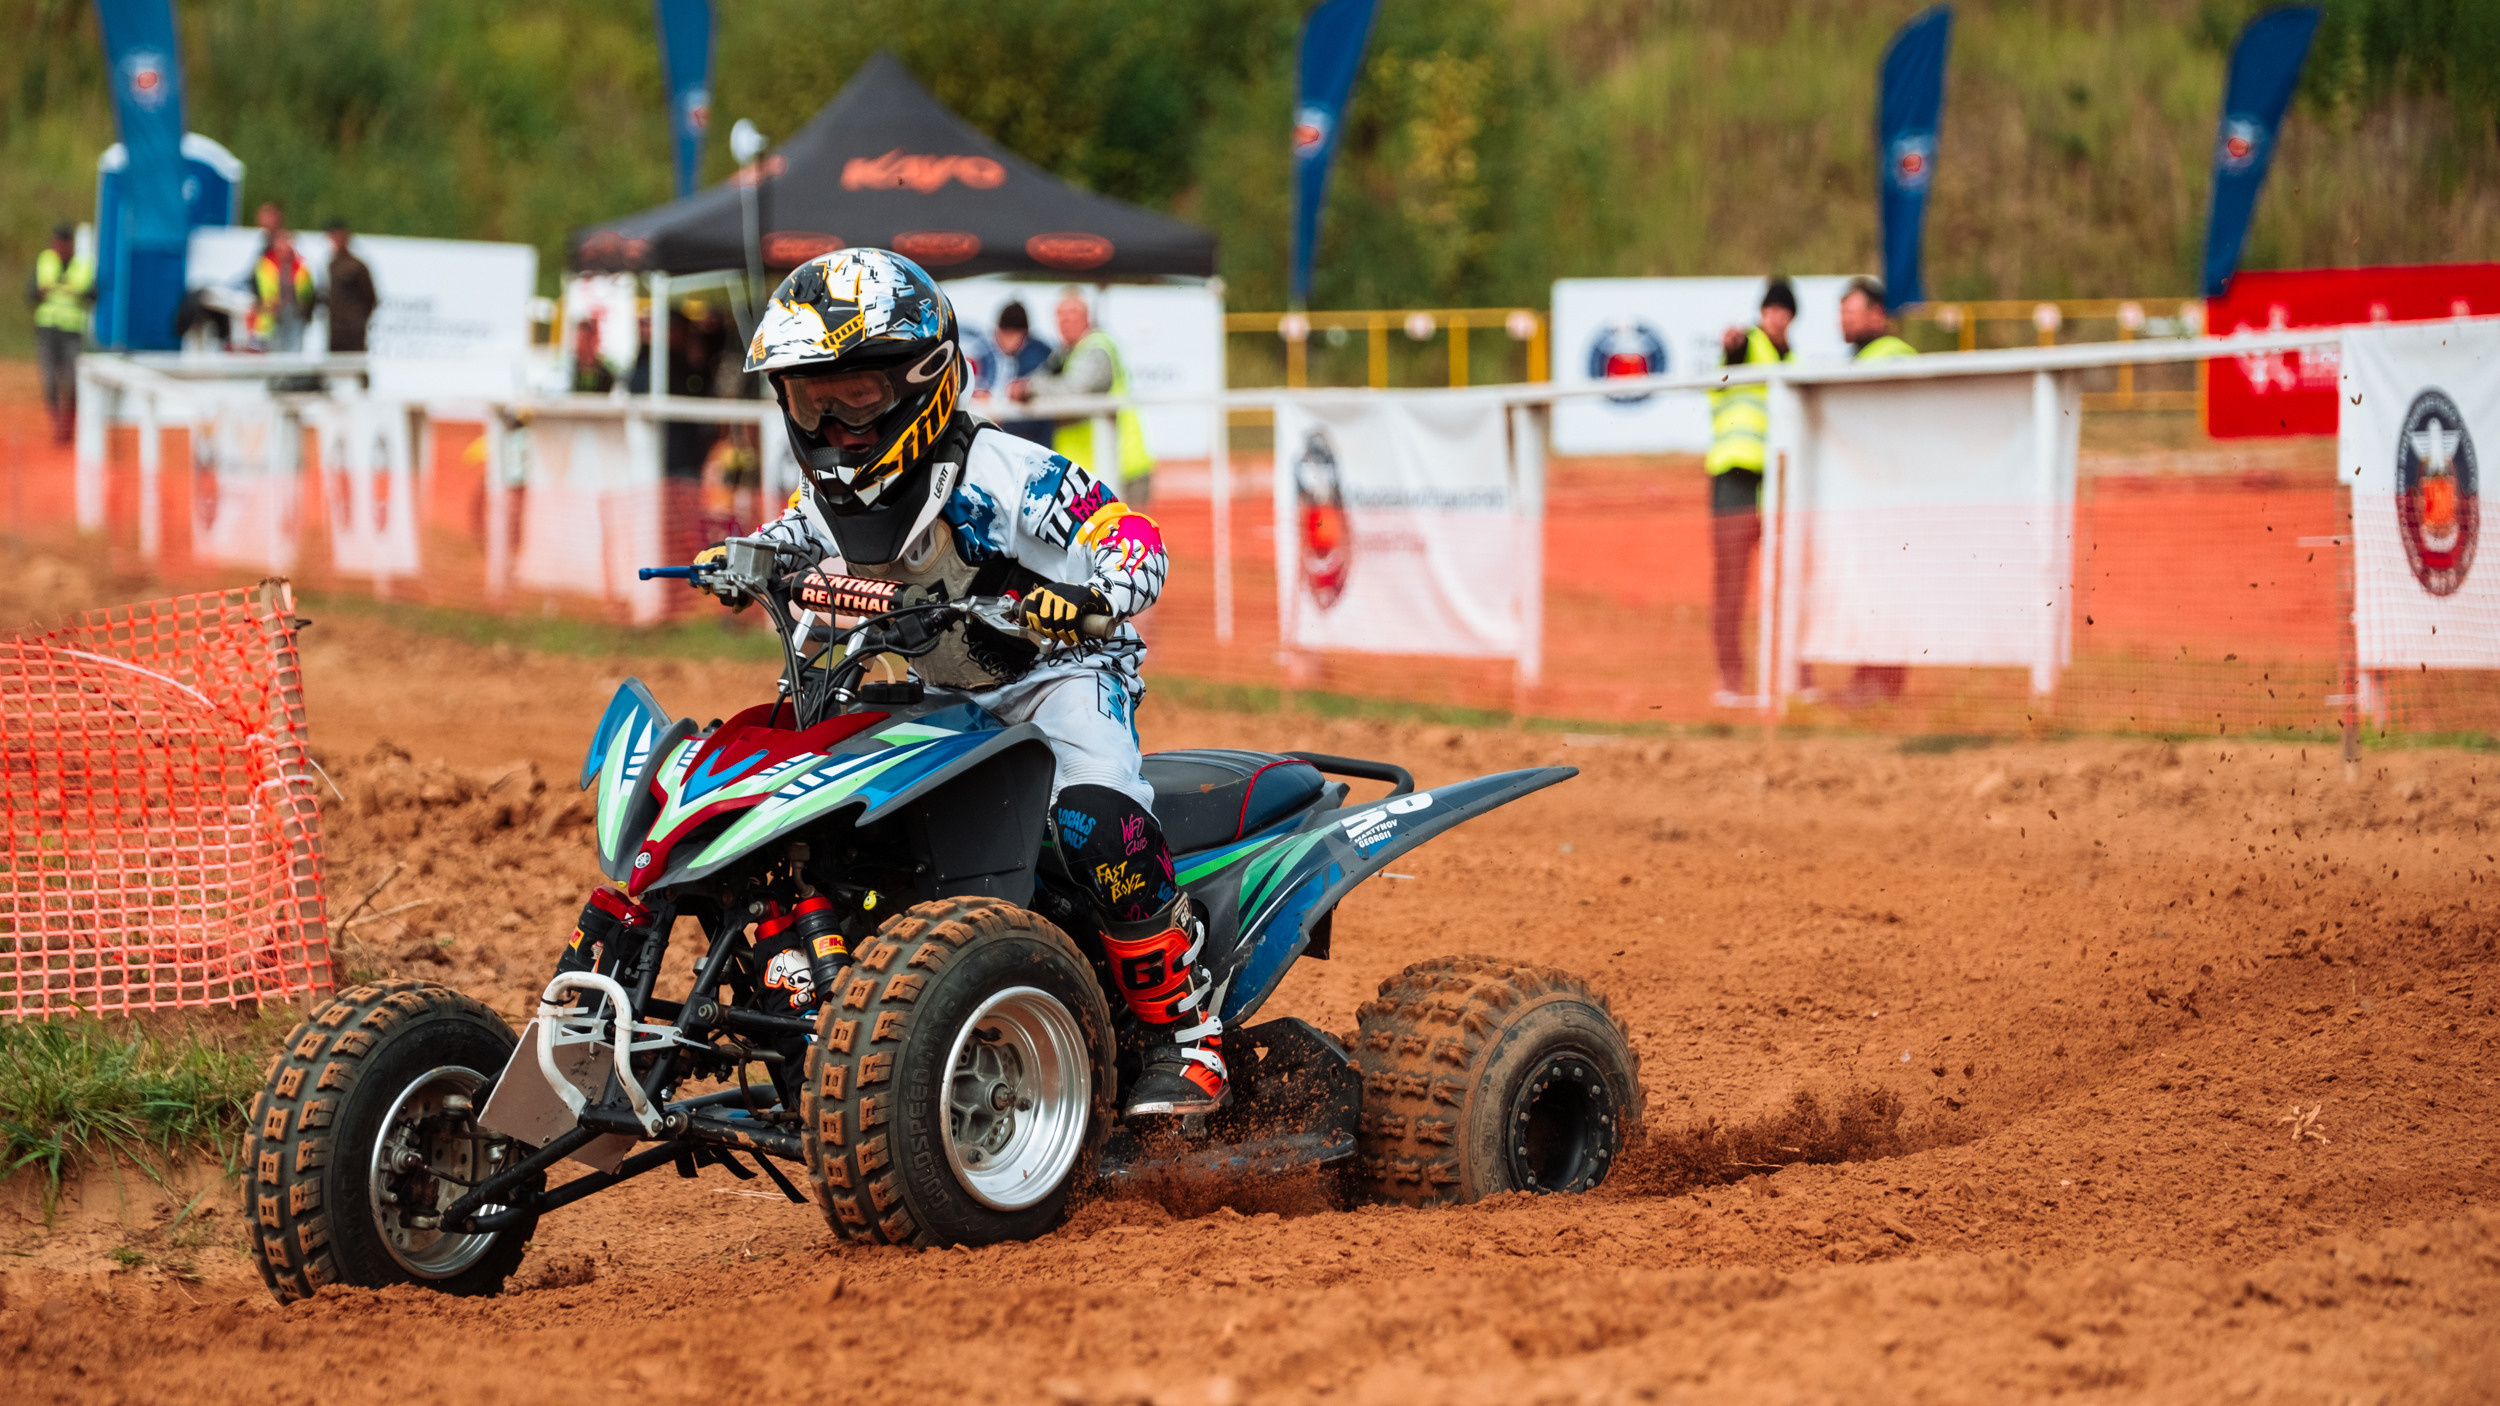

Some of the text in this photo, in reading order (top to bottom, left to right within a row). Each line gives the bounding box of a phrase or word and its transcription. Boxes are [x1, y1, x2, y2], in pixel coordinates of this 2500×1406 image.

[801, 472, 811, 501] EATT
[933, 464, 949, 499] LEATT
[803, 573, 896, 597] RENTHAL
[802, 587, 893, 613] RENTHAL
[1058, 807, 1096, 836] LOCALS
[1120, 813, 1144, 843] WFO
[1354, 819, 1398, 843] MARTYNOV
[1063, 828, 1088, 849] ONLY
[1125, 837, 1148, 856] CLUB
[1359, 830, 1391, 848] GEORGII
[1095, 860, 1128, 885] FAST
[908, 1067, 950, 1210] GOLDSPEED
